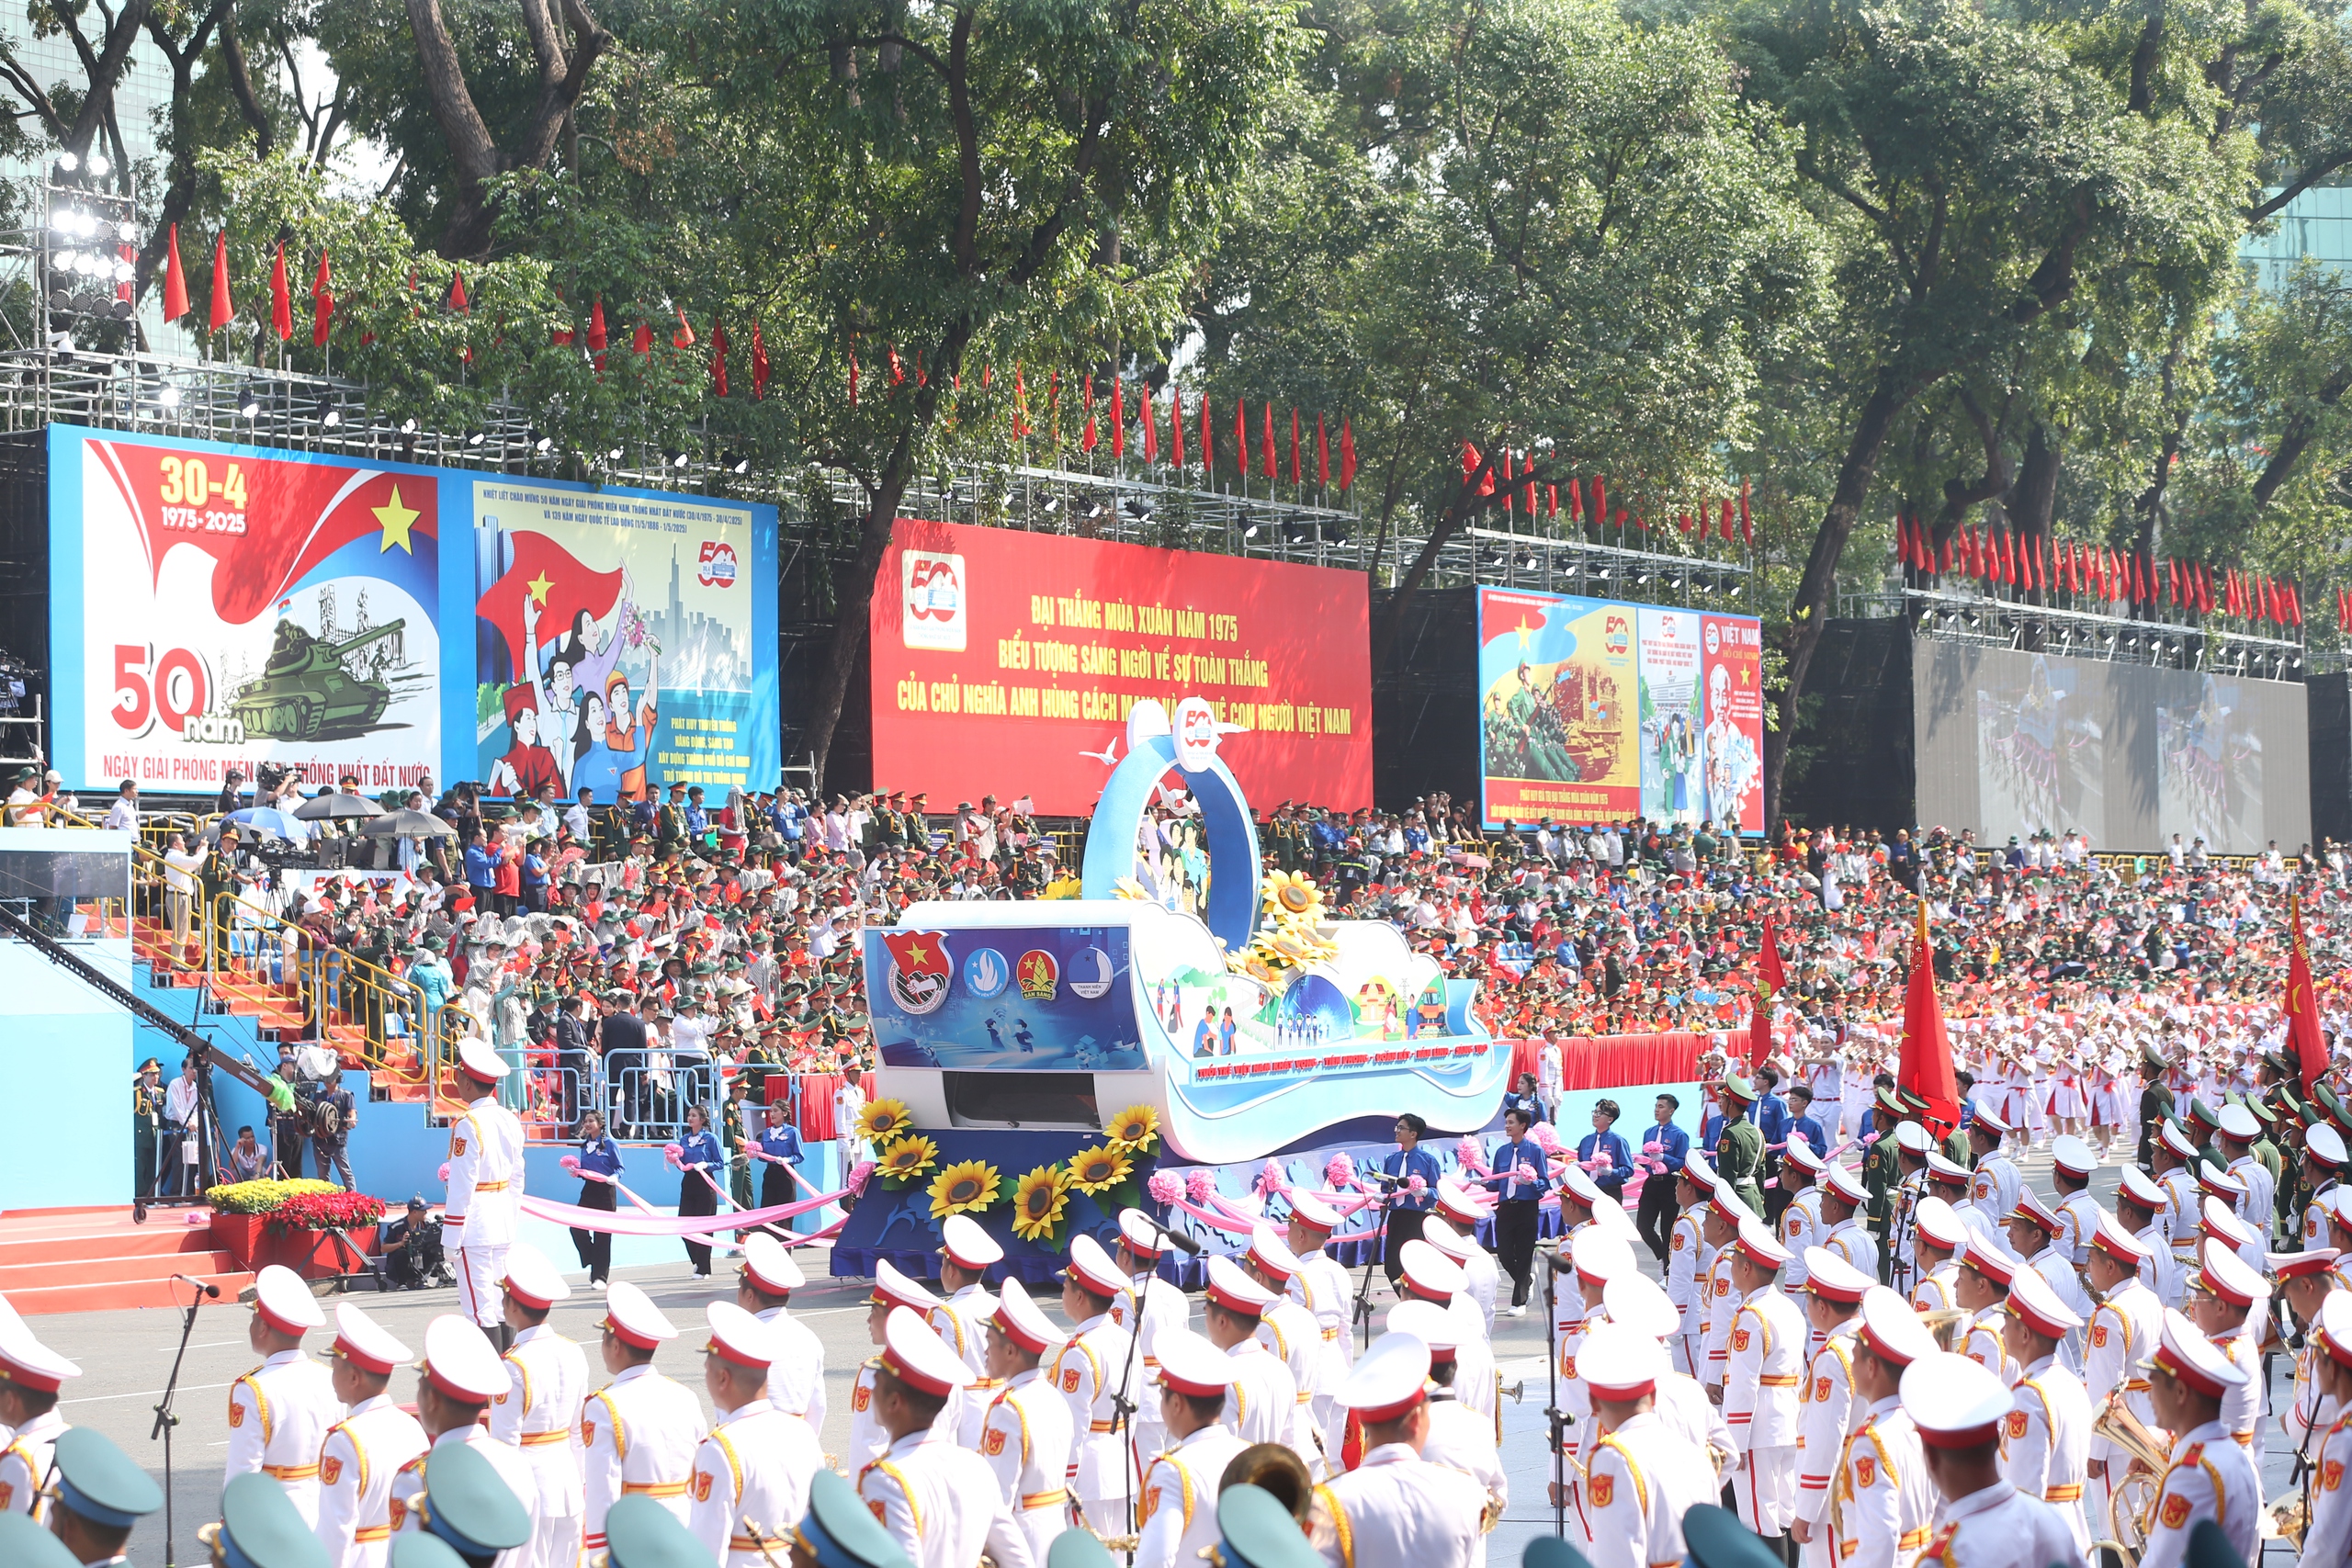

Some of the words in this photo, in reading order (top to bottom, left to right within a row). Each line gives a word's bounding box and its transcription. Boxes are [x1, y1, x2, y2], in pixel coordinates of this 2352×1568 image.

[160, 456, 247, 510] 30-4
[510, 491, 523, 502] CHÀO
[541, 495, 548, 504] 50
[549, 495, 560, 505] NĂM
[561, 496, 574, 507] NGÀY
[576, 497, 586, 508] GIẢI
[588, 499, 604, 511] PHÓNG
[632, 504, 648, 515] THỐNG
[649, 505, 662, 516] NHẤT
[673, 508, 685, 519] NƯỚC
[544, 510, 551, 519] VÀ
[562, 511, 573, 522] NĂM
[575, 512, 588, 523] NGÀY
[589, 513, 603, 525] QUỐC
[611, 516, 619, 526] LAO
[1031, 595, 1055, 631] ĐẠI
[1057, 589, 1102, 629] THẮNG
[1104, 598, 1135, 633] MÙA
[1137, 602, 1173, 636] XUÂN
[1176, 605, 1205, 639] NĂM
[1209, 614, 1238, 642] 1975
[1721, 622, 1739, 647] VIỆT
[1741, 627, 1758, 646] NAM
[998, 628, 1030, 670] BIỂU
[1033, 639, 1077, 678] TƯỢNG
[1080, 640, 1116, 675] SÁNG
[1120, 644, 1151, 679] NGỜI
[1154, 644, 1170, 681] VỀ
[1173, 652, 1192, 688] SỰ
[1193, 651, 1226, 684] TOÀN
[1228, 649, 1268, 687] THẮNG
[111, 644, 206, 732] 50
[897, 671, 927, 711] CỦA
[931, 673, 960, 713] CHỦ
[963, 680, 1007, 715] NGHĨA
[1010, 687, 1038, 716] ANH
[1042, 683, 1079, 719] HÙNG
[1081, 686, 1117, 721] CÁCH
[1230, 702, 1255, 730] CON
[1258, 699, 1294, 732] NGƯỜI
[1296, 701, 1321, 739] VIỆT
[1324, 706, 1351, 735] NAM
[184, 710, 245, 745] năm
[104, 751, 138, 778] NGÀY
[143, 750, 168, 779] GIẢI
[174, 754, 216, 781] PHÓNG
[339, 756, 368, 786] NHẤT
[373, 757, 395, 786] ĐẤT
